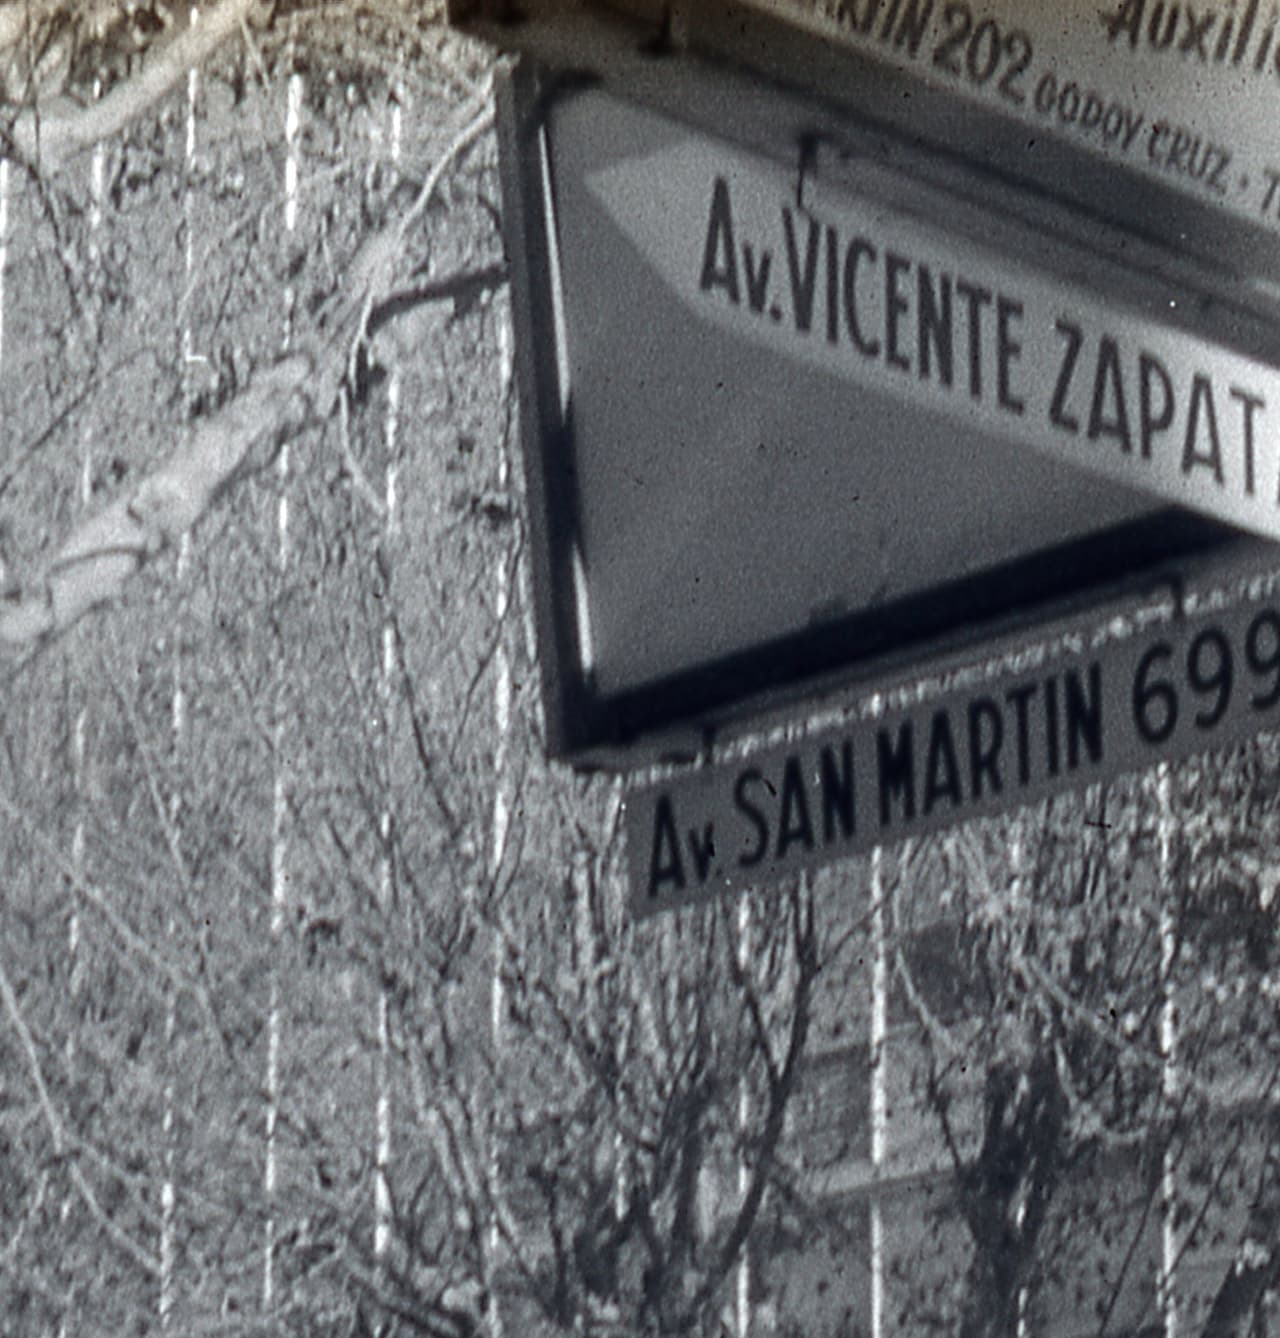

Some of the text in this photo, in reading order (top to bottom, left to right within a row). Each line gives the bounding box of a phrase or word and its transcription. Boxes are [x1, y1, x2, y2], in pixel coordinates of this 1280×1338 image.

[932, 2, 1033, 104] 202
[1035, 72, 1144, 151] GODOY
[1147, 120, 1233, 196] CRUZ
[699, 174, 782, 322] Av.
[781, 206, 1025, 417] VICENTE
[733, 740, 857, 867] SAN
[875, 658, 1105, 826] MARTIN
